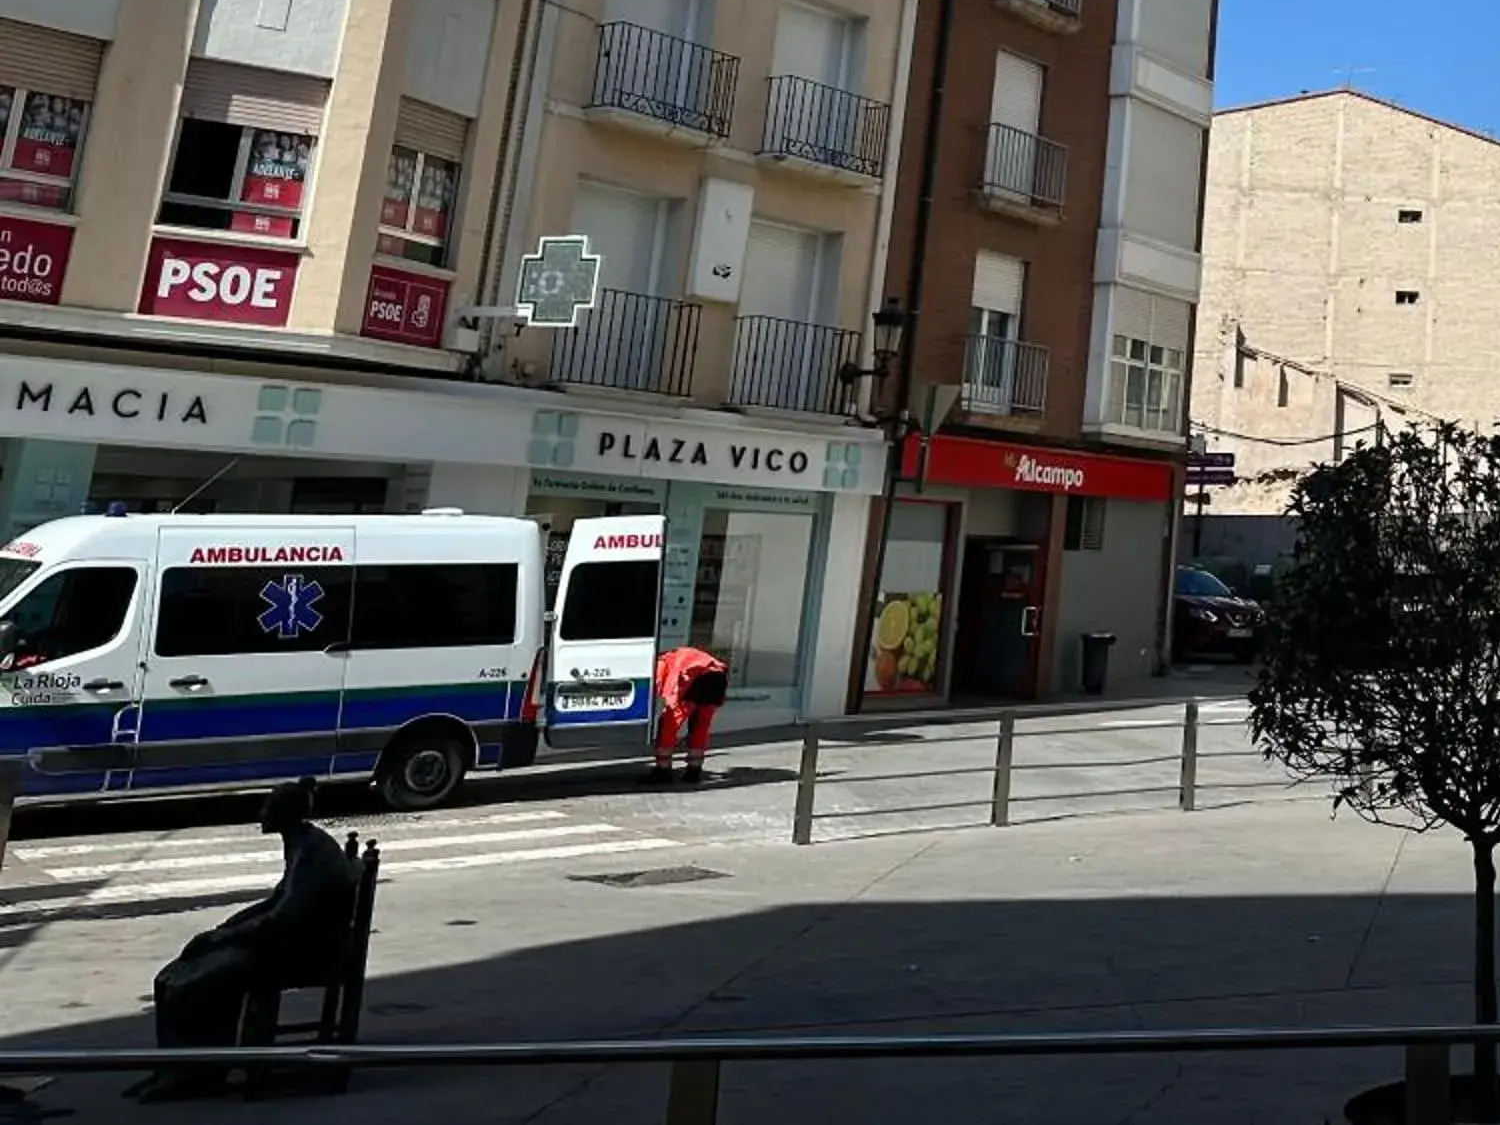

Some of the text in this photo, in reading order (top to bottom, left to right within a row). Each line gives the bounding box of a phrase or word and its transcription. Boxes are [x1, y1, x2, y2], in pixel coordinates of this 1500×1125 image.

[157, 258, 282, 308] PSOE
[370, 300, 403, 322] PSOE
[16, 381, 208, 423] MACIA
[598, 432, 808, 473] PLAZA VICO
[1014, 454, 1084, 491] Alcampo
[190, 546, 344, 563] AMBULANCIA
[13, 673, 81, 690] La Rioja
